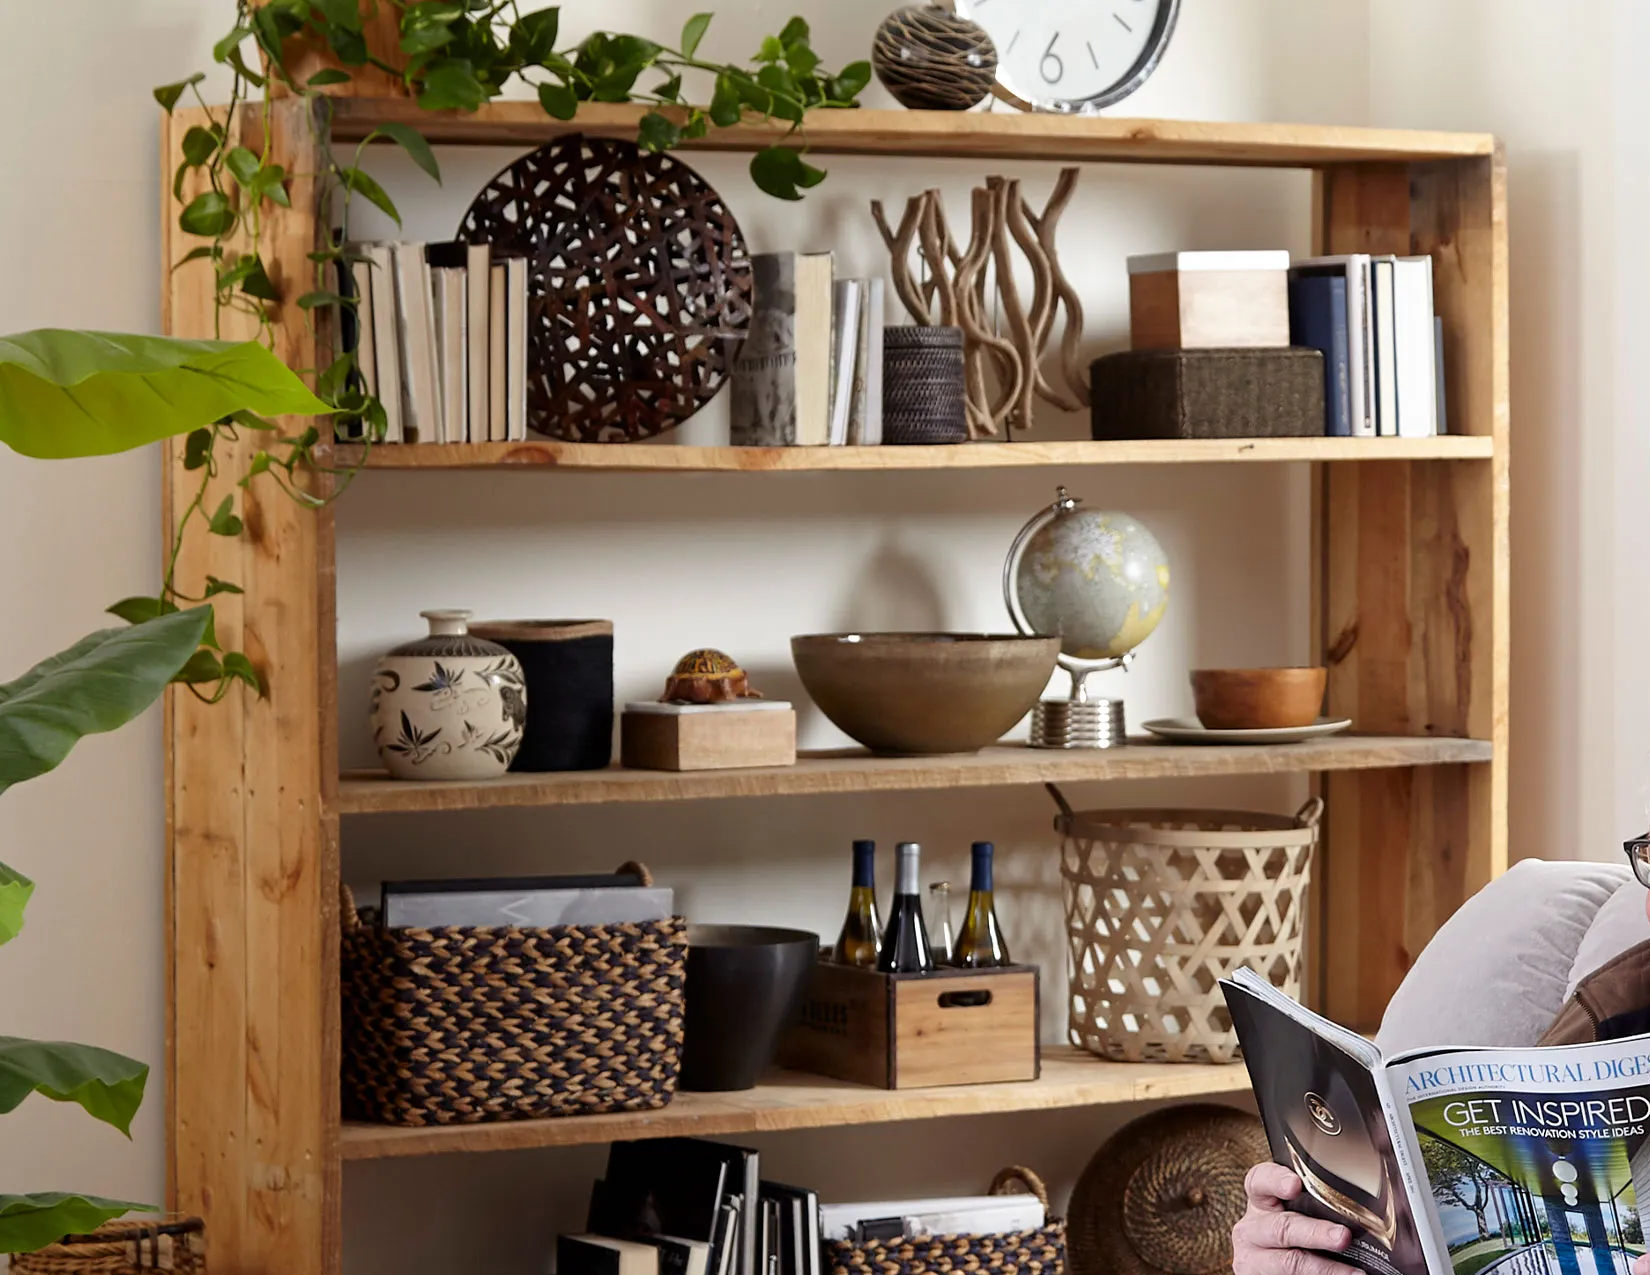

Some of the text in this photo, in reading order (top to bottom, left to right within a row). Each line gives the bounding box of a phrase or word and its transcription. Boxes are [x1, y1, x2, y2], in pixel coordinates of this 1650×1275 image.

[1040, 31, 1063, 85] 6
[1405, 1062, 1592, 1095] ARCHITECTURAL
[1443, 1099, 1502, 1127] GET
[1458, 1125, 1645, 1139] THE BEST RENOVATION STYLE IDEAS
